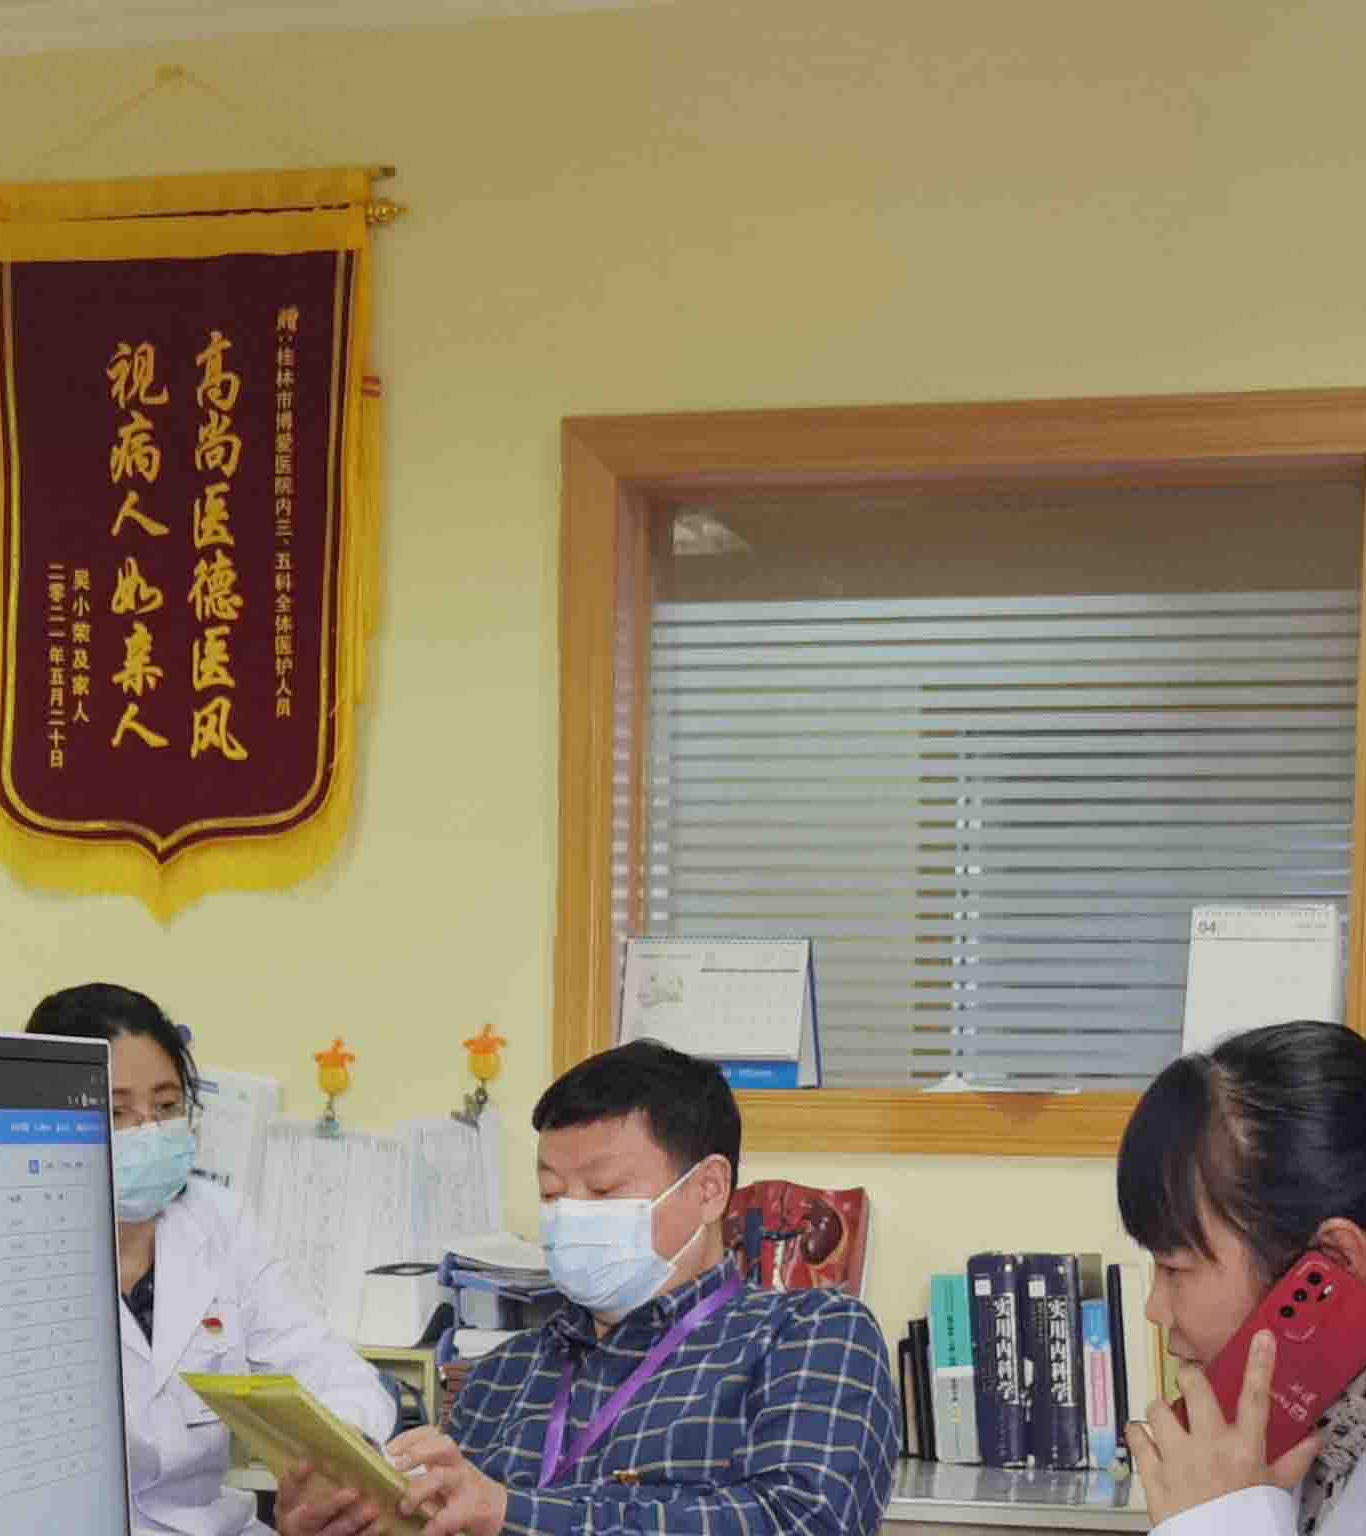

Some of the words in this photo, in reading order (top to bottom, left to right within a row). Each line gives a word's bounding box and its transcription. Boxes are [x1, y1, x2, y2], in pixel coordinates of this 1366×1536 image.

[47, 563, 67, 769] 二零二一年五月二十日
[105, 341, 169, 750] 视病人如亲人
[188, 329, 248, 761] 高尚医德医风
